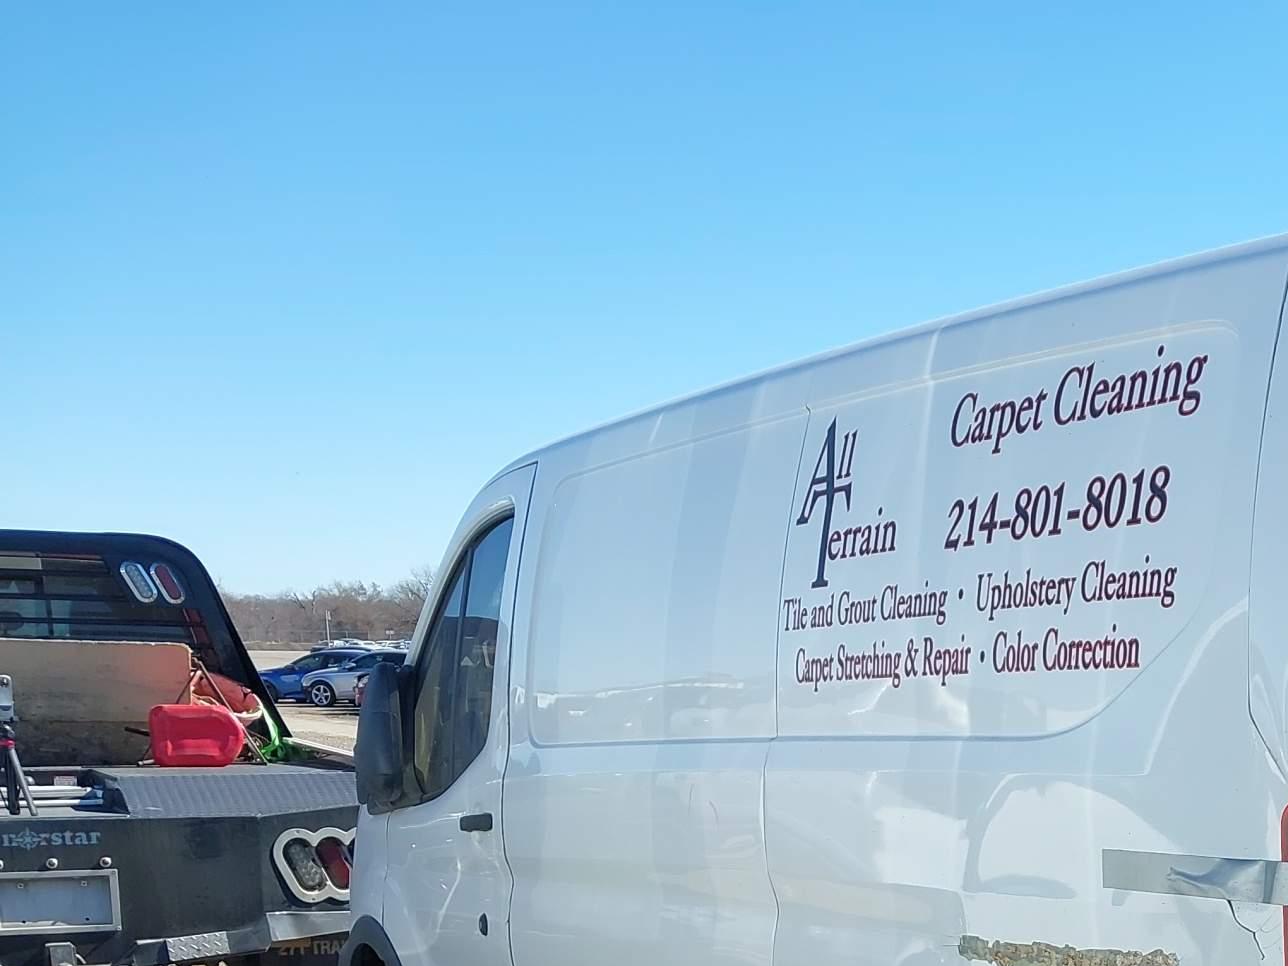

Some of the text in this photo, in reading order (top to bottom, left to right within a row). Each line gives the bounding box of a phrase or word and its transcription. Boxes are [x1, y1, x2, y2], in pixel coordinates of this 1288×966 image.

[951, 345, 1208, 454] Carpet Cleaning
[796, 416, 858, 526] All
[944, 465, 1171, 551] 214-801-8018
[806, 481, 897, 588] Terrain
[783, 596, 808, 631] Tile
[810, 592, 835, 628] and
[838, 590, 877, 626] Grout
[880, 580, 948, 625] Cleaning
[976, 568, 1077, 621] Upholstery
[1081, 555, 1178, 608] Cleaning
[795, 647, 834, 692] Carpet
[836, 640, 901, 688] Stretching
[904, 638, 919, 678] &
[922, 634, 971, 686] Repair
[992, 630, 1039, 673] Color
[1042, 623, 1140, 672] Correction
